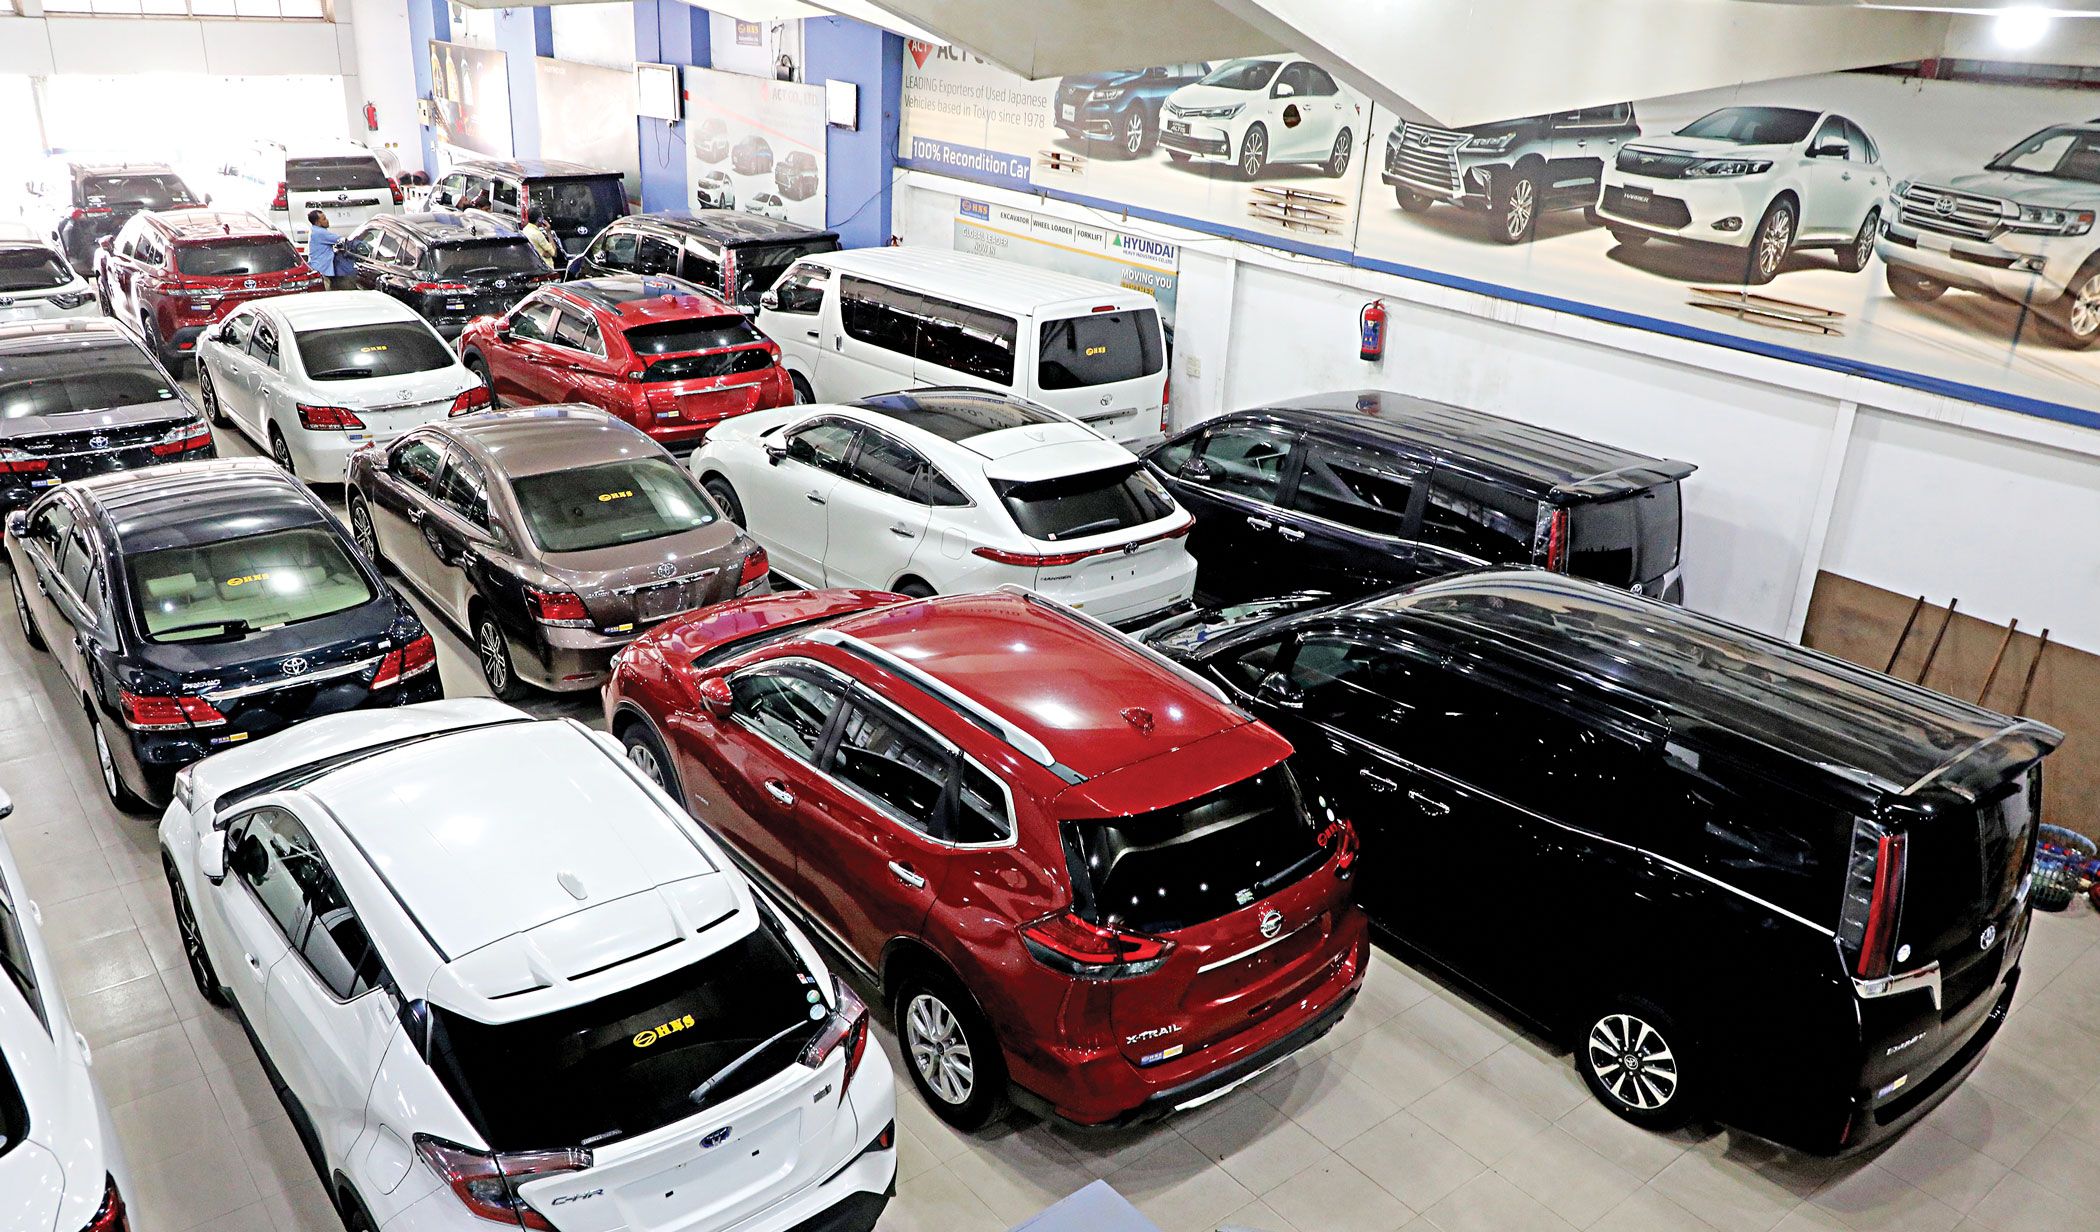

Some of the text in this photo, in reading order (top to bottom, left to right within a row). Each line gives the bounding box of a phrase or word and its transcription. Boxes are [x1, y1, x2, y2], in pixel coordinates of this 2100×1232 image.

[911, 40, 928, 52] ACT
[905, 75, 1047, 108] LEADING Exporters of Used Japanese
[904, 94, 1045, 129] Vehicles based in Tokyo since 1978
[913, 141, 1030, 179] 100% Recondition Car
[1000, 212, 1030, 225] EXCAVATOR
[1033, 220, 1073, 235] WHEEL LOADER
[962, 227, 1009, 247] GLOBAL LEADER
[1077, 229, 1103, 242] FORKLIFT
[974, 241, 989, 253] NOW
[989, 245, 996, 256] IN
[1123, 236, 1175, 259] HYUNDAI
[1123, 249, 1136, 257] HEAVY
[1136, 252, 1158, 262] INDUSTRIES
[1121, 268, 1173, 290] MOVING YOU
[243, 573, 270, 583] HNS
[654, 1014, 696, 1039] HNS
[1125, 1024, 1182, 1045] X-TRAIL
[551, 1188, 604, 1206] C-HR
